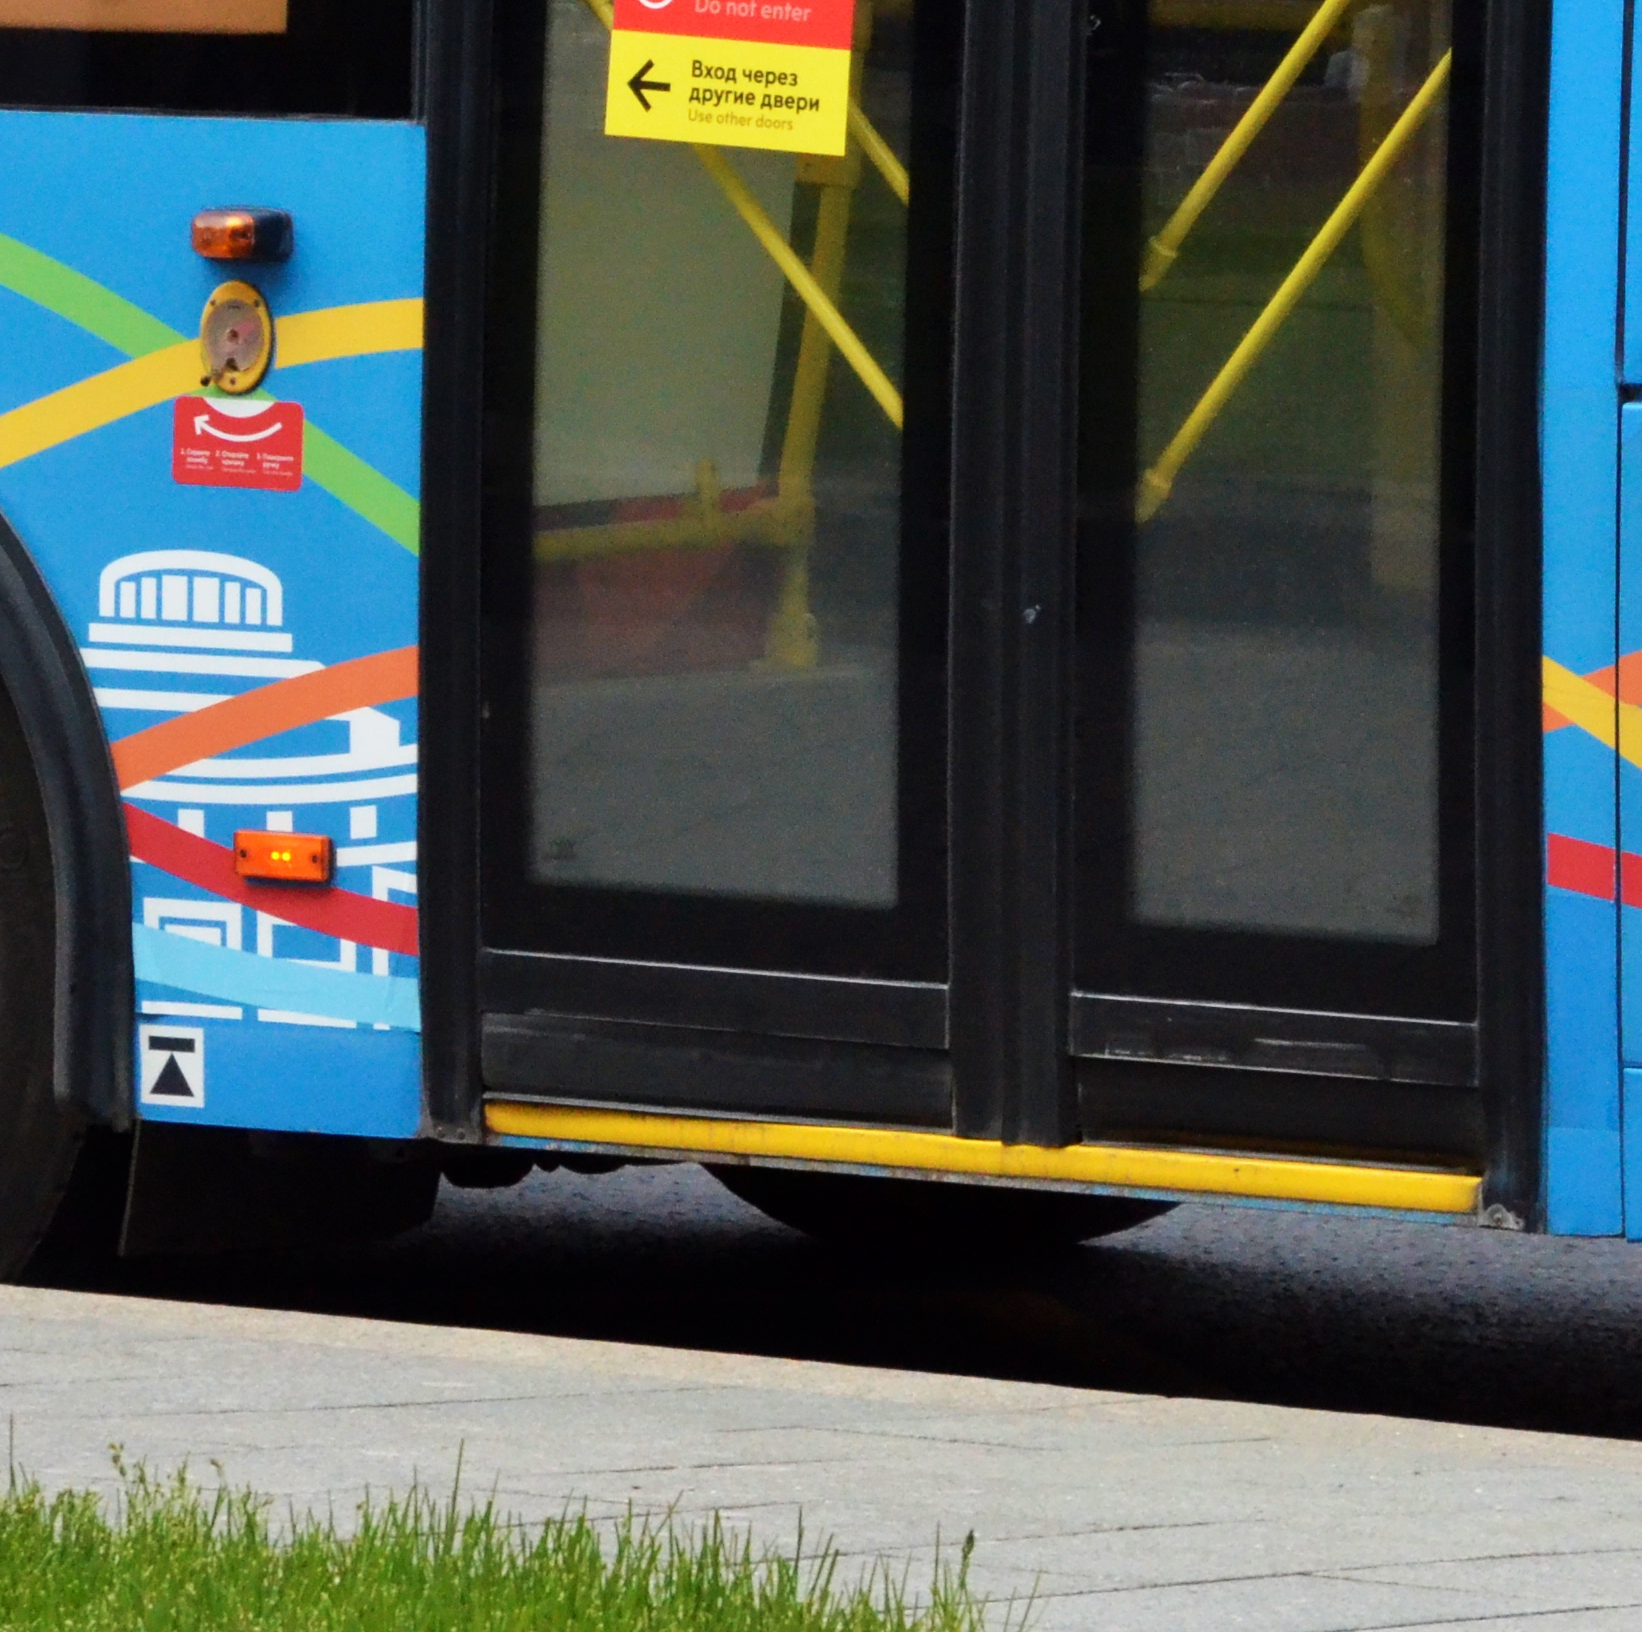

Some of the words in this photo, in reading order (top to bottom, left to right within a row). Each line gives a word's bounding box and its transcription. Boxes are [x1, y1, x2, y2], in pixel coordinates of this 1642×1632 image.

[760, 3, 812, 22] enter
[691, 59, 737, 84] Вход
[742, 67, 799, 89] через
[688, 85, 756, 109] другие
[760, 94, 820, 116] двери
[687, 108, 713, 123] Use
[716, 111, 753, 128] other
[755, 115, 794, 131] doors
